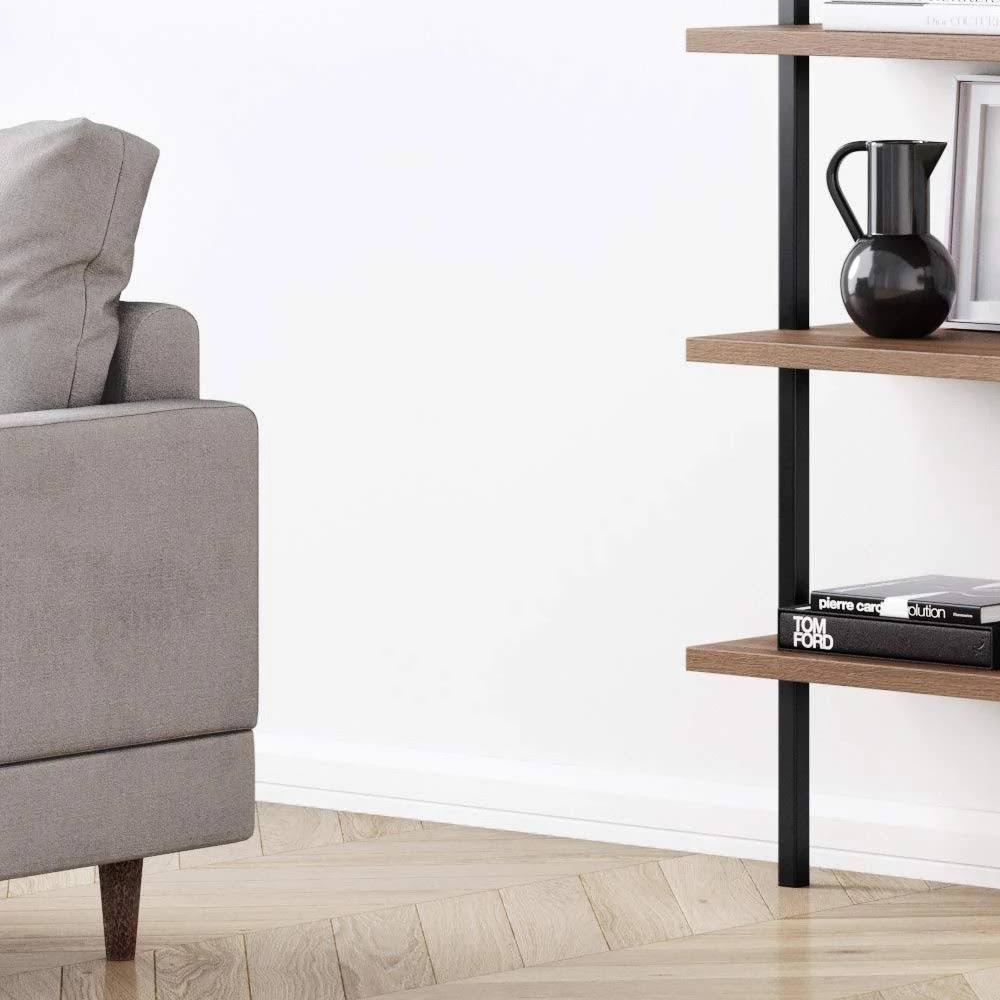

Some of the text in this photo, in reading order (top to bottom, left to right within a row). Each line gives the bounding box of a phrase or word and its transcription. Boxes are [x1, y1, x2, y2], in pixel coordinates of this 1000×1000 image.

[818, 596, 854, 610] pierre
[856, 601, 884, 614] card
[907, 603, 946, 618] olution
[793, 615, 826, 634] TOM
[793, 631, 834, 650] FORD
